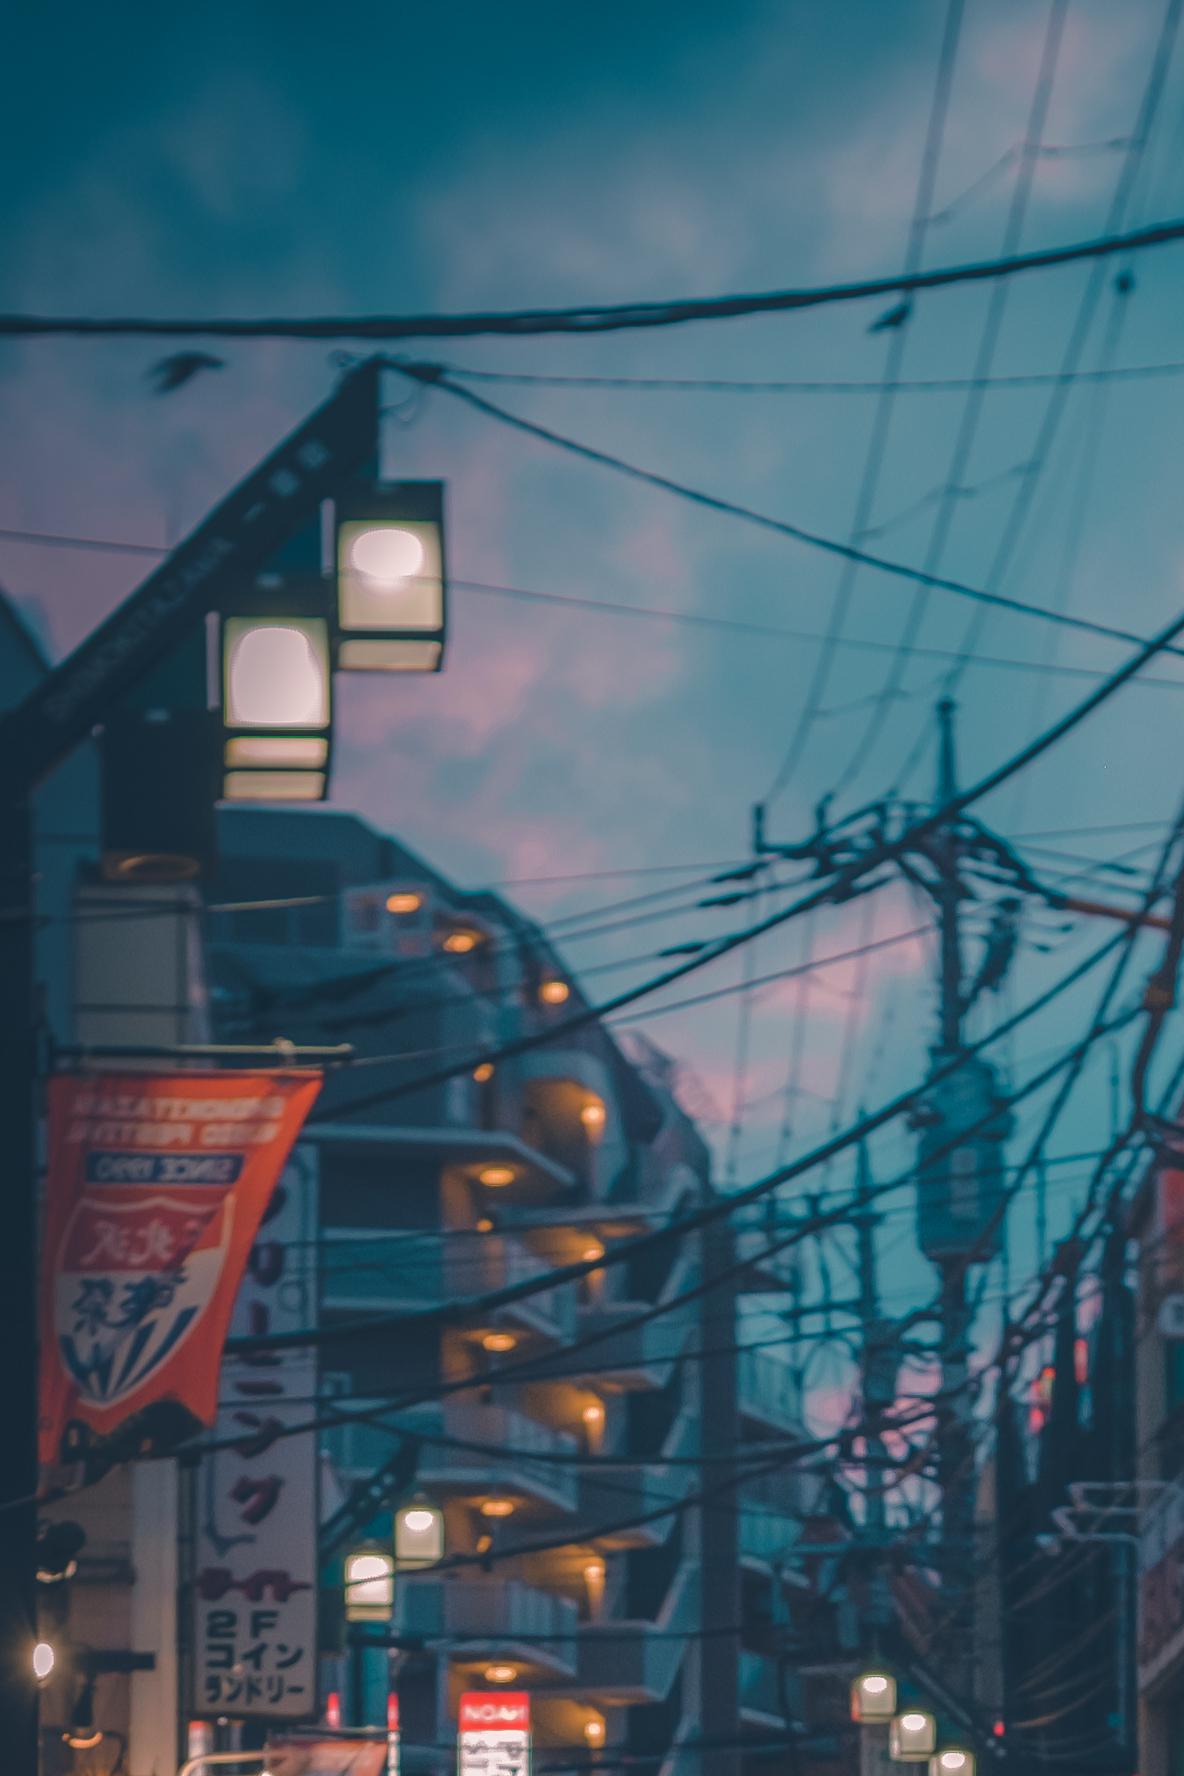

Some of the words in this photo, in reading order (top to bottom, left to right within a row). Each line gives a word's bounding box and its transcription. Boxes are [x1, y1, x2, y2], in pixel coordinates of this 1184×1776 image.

[206, 1610, 281, 1639] 2F
[206, 1641, 304, 1671] コイン
[205, 1674, 305, 1704] ランドリー
